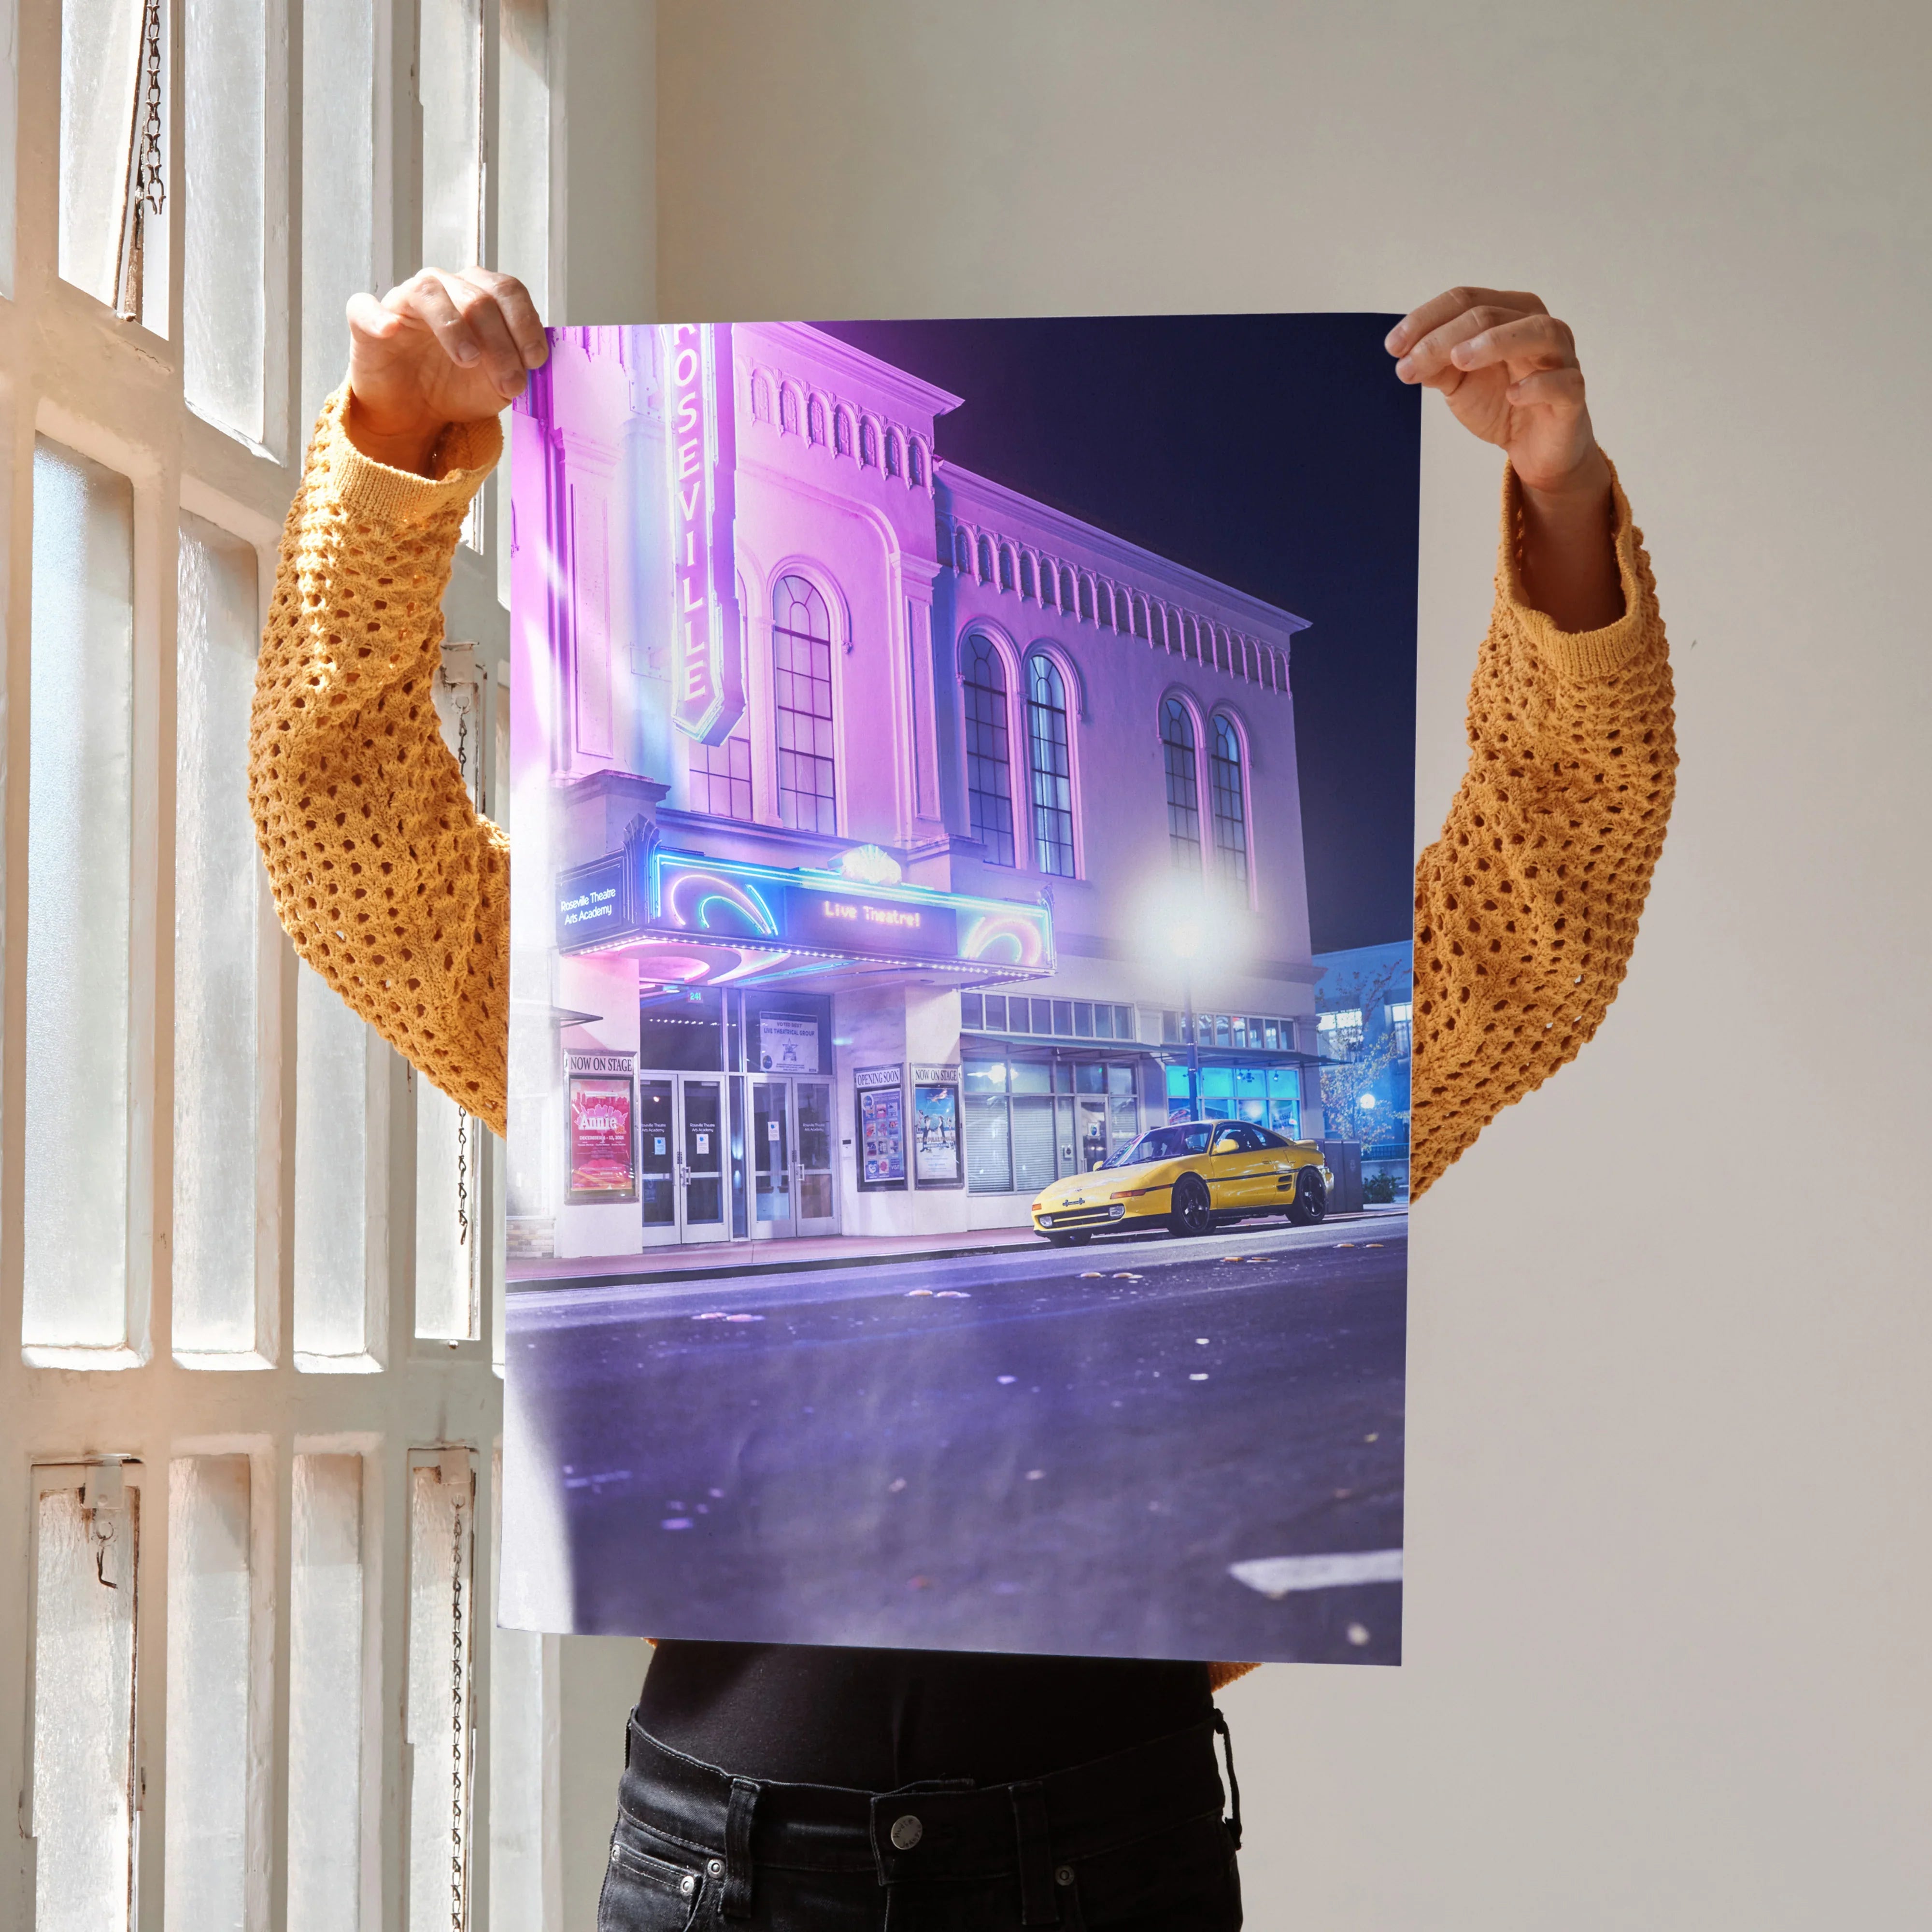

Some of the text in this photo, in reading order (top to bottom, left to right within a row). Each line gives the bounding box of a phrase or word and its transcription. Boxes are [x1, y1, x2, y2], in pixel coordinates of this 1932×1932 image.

[561, 888, 616, 912] Roseville Theatre
[564, 904, 612, 925] Arts Academy
[824, 900, 920, 927] Live Theatre!
[690, 992, 701, 1000] 241
[571, 1056, 632, 1072] NOW ON STAGE
[857, 1069, 899, 1086] OPENING SOON
[916, 1069, 957, 1081] NOW ON STAGE
[578, 1114, 617, 1131] Annie
